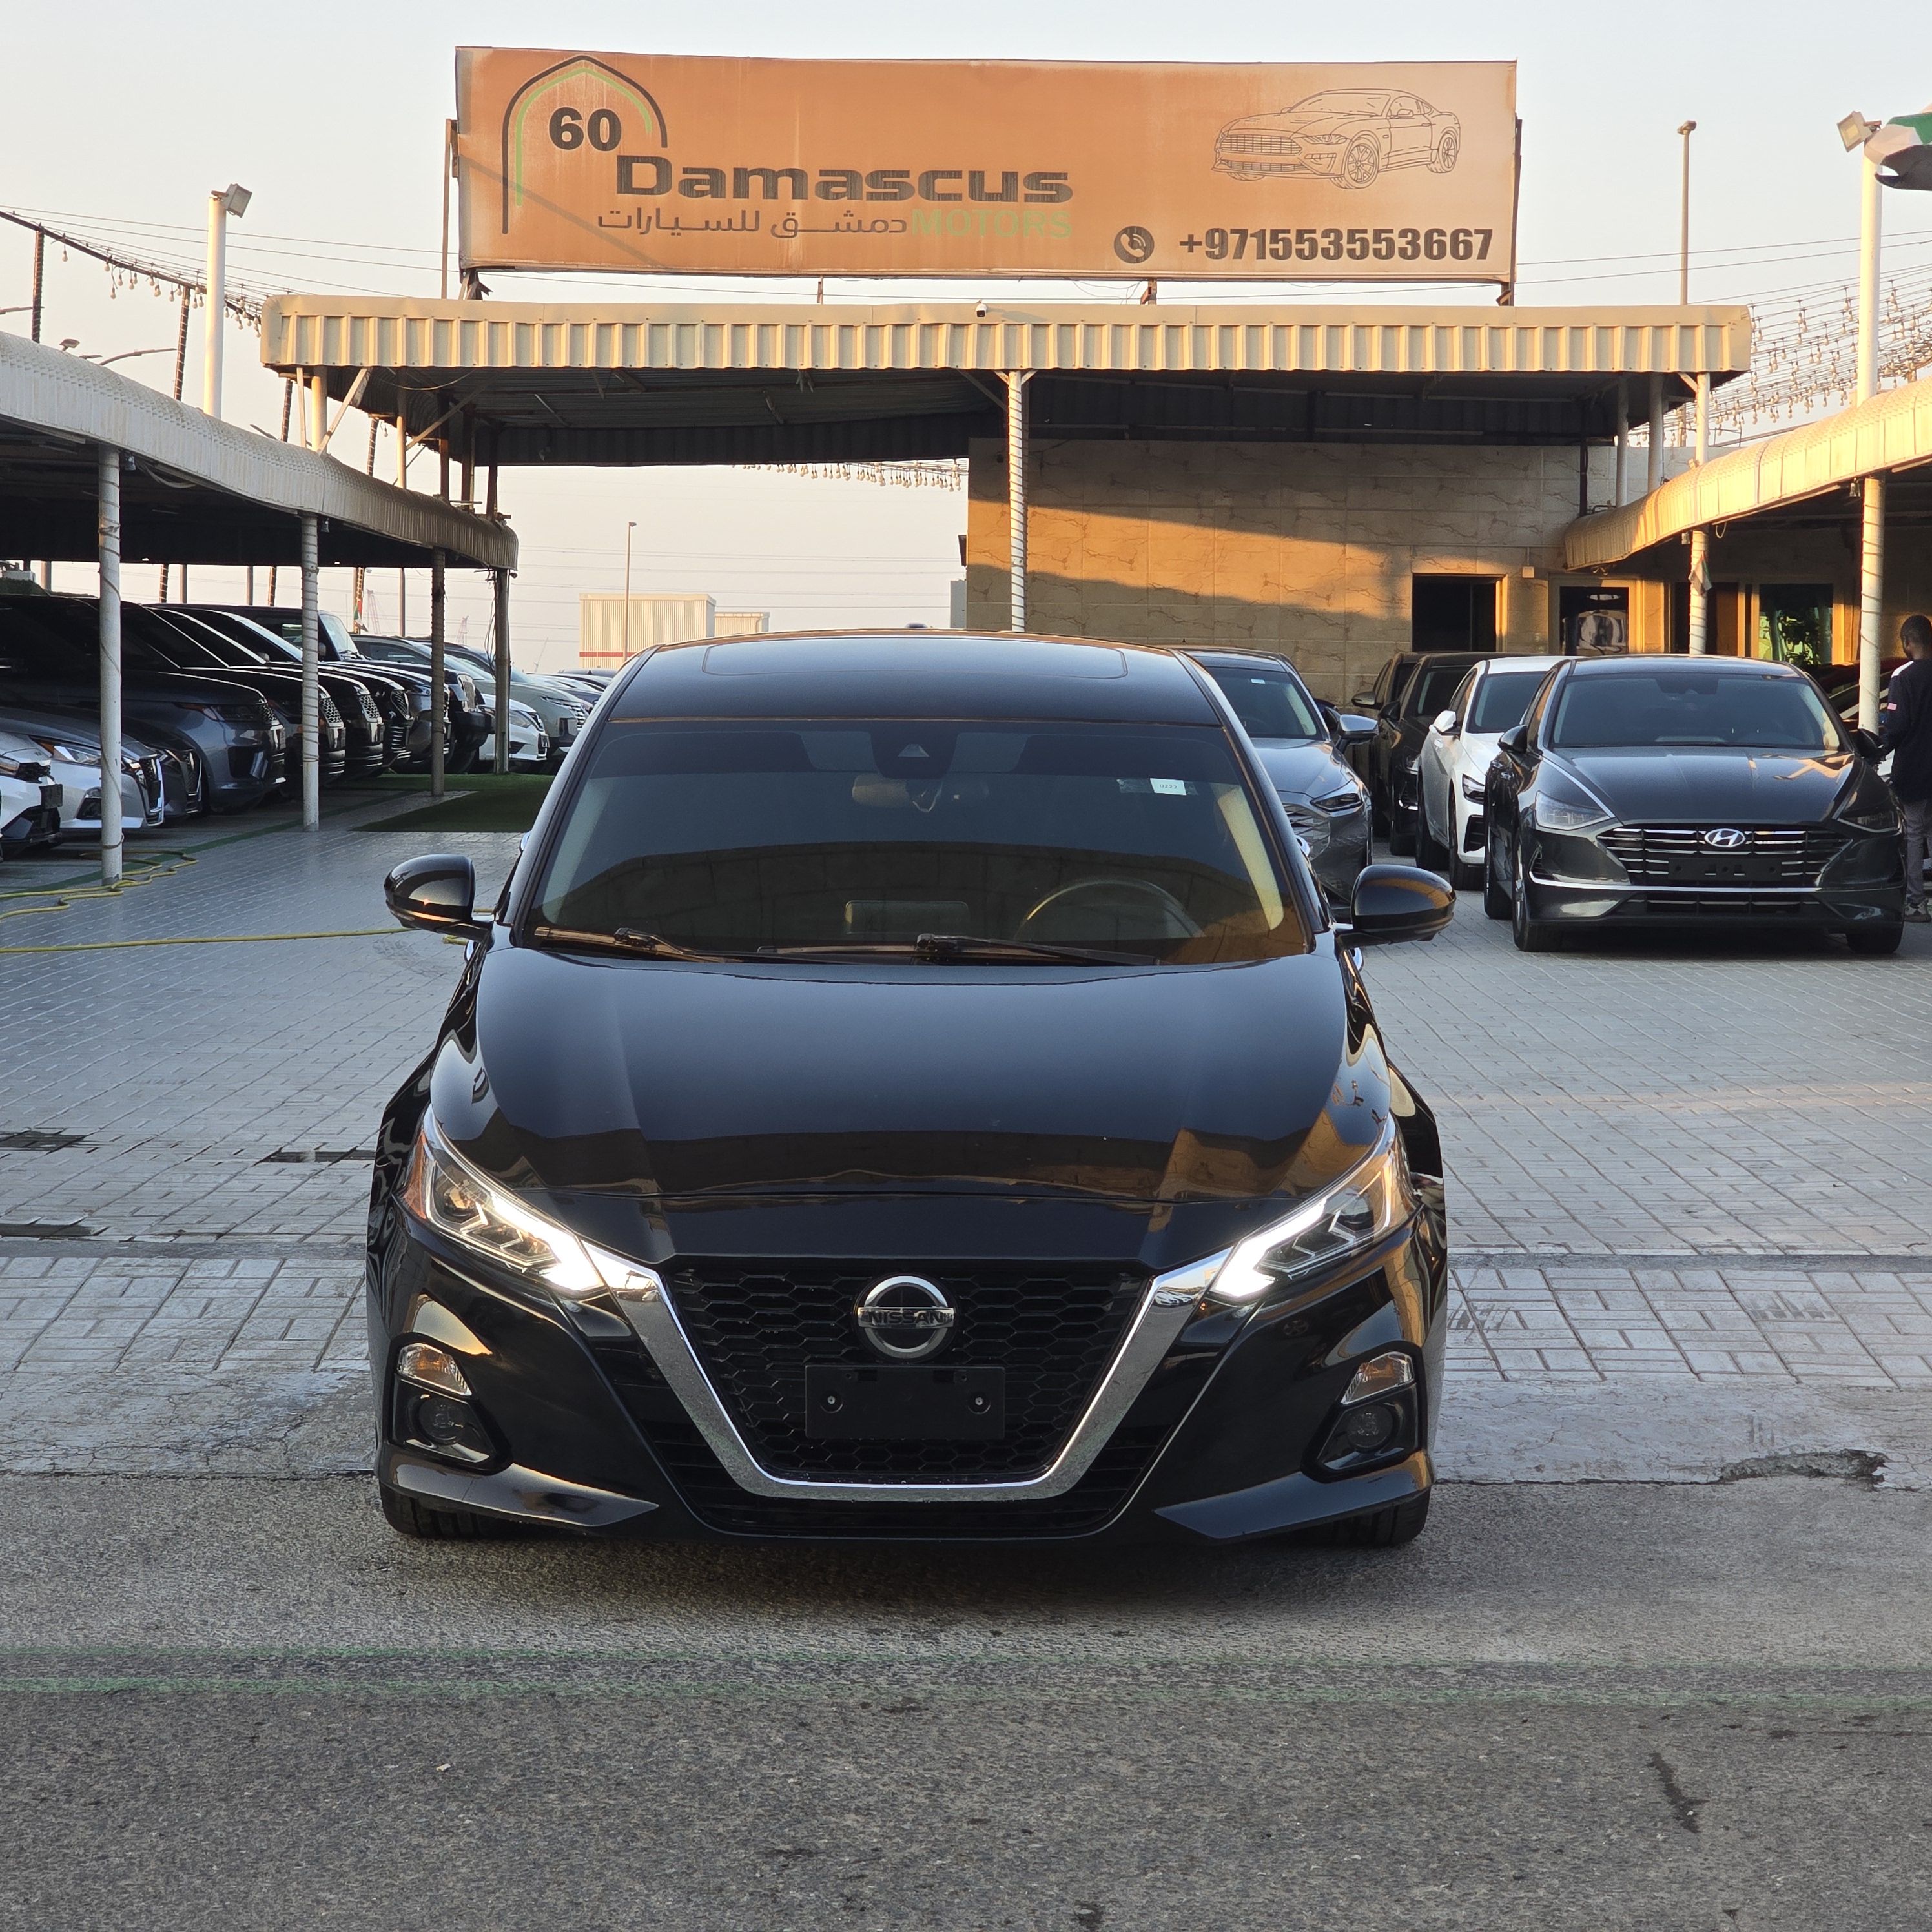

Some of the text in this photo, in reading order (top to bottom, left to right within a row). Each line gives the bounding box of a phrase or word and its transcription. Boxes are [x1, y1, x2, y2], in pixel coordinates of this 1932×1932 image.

[549, 107, 622, 151] 60
[617, 155, 1073, 203] Damascus
[598, 207, 907, 238] دمشق للسيارات
[912, 208, 1073, 239] MOTORS
[1179, 227, 1492, 260] +971553553667
[868, 1311, 944, 1325] NISSAN
